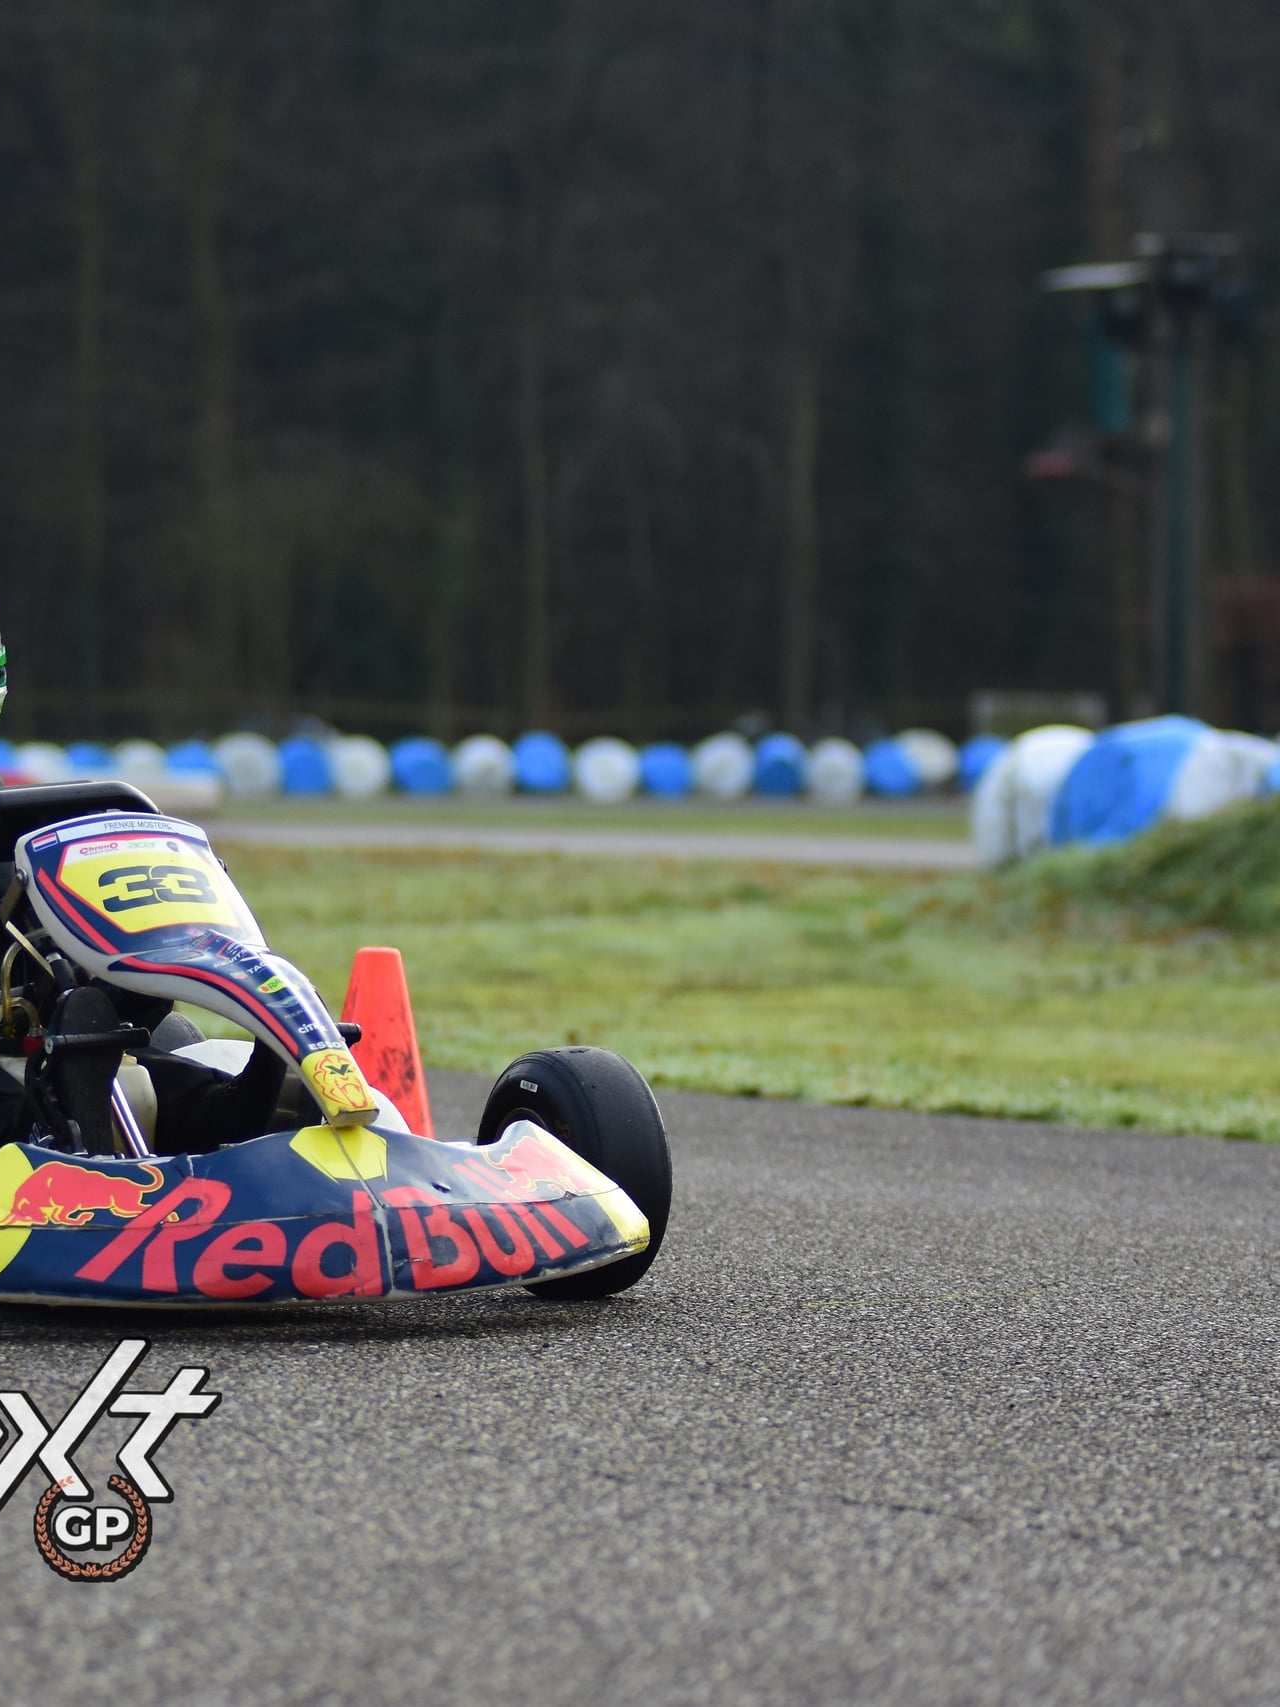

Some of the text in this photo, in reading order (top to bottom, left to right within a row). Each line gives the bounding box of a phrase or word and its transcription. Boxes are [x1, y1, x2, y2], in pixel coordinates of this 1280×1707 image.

[98, 865, 217, 913] 33
[74, 1157, 591, 1299] Red Bull
